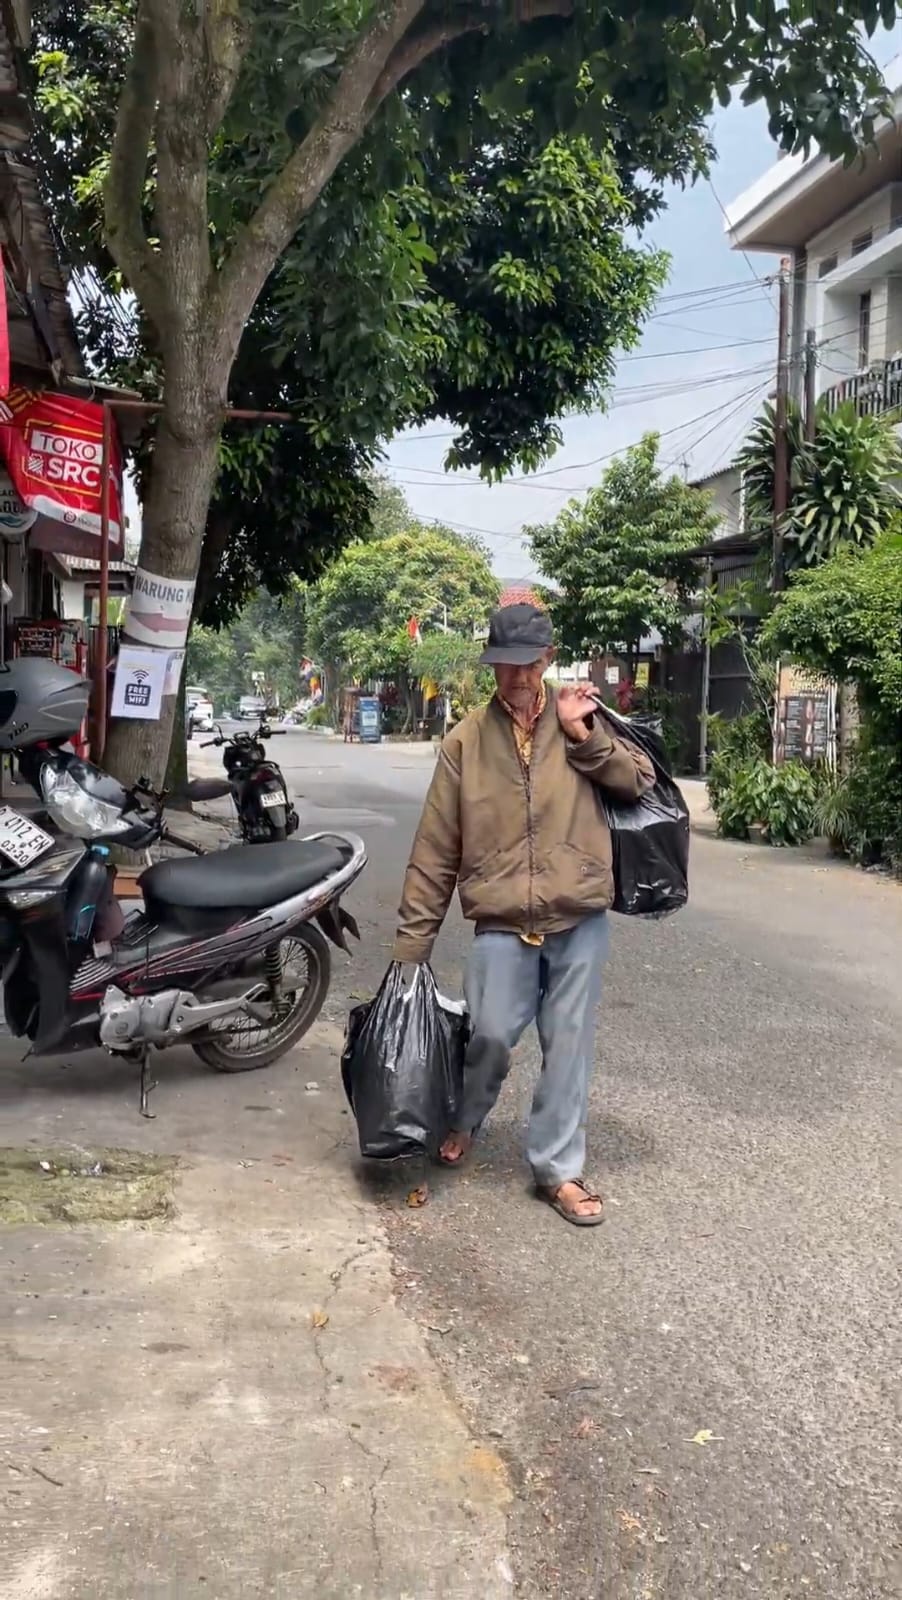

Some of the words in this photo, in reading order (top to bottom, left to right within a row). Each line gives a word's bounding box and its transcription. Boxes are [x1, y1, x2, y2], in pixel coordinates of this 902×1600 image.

[40, 434, 96, 460] TOKO
[47, 457, 100, 487] SRC
[135, 575, 185, 603] WARUNG
[128, 686, 149, 695] FREE
[128, 696, 146, 704] WIFI
[28, 834, 51, 852] EN
